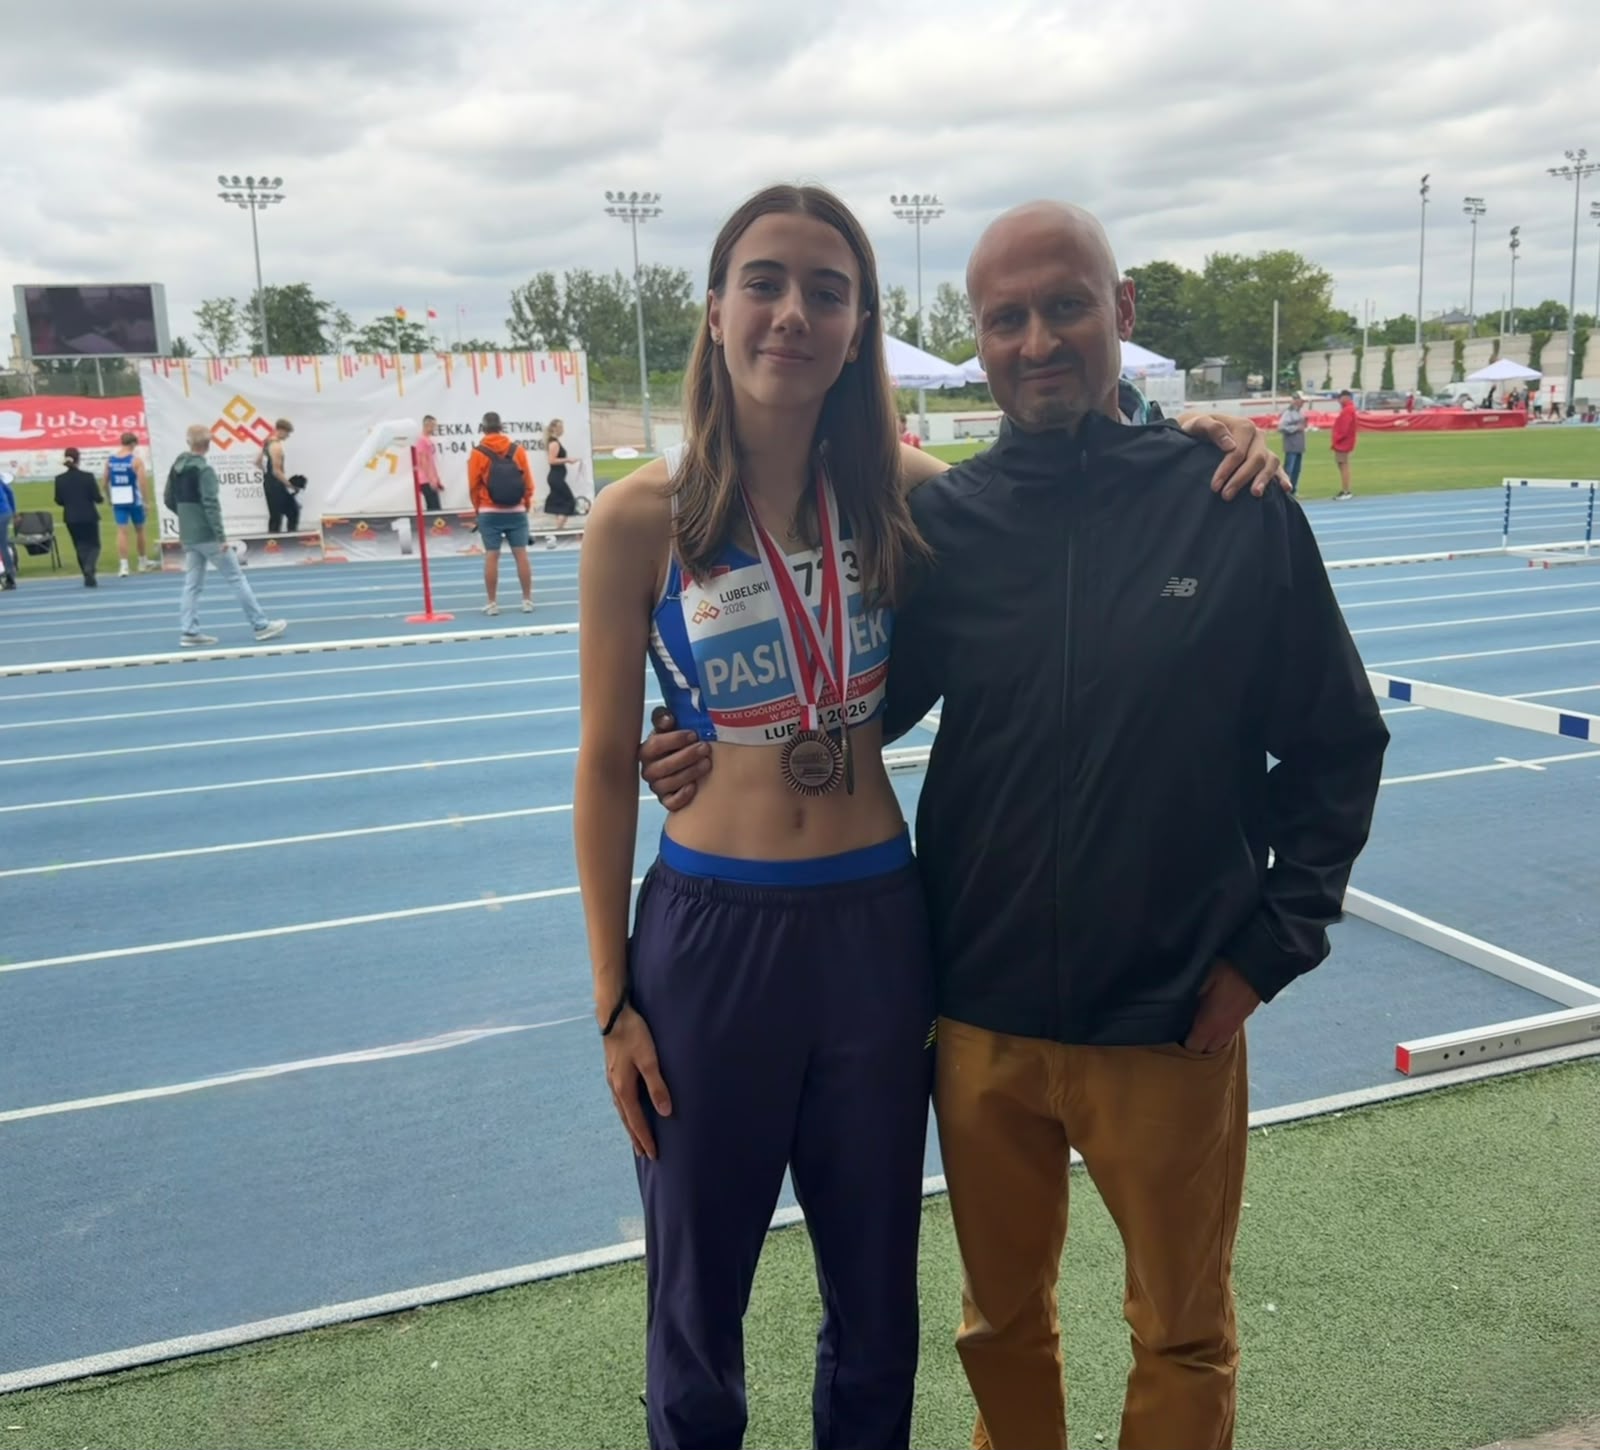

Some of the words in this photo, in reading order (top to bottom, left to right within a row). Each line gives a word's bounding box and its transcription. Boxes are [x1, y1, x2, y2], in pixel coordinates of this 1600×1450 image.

[391, 517, 413, 555] 1
[792, 550, 861, 597] 73
[723, 601, 746, 615] 2026
